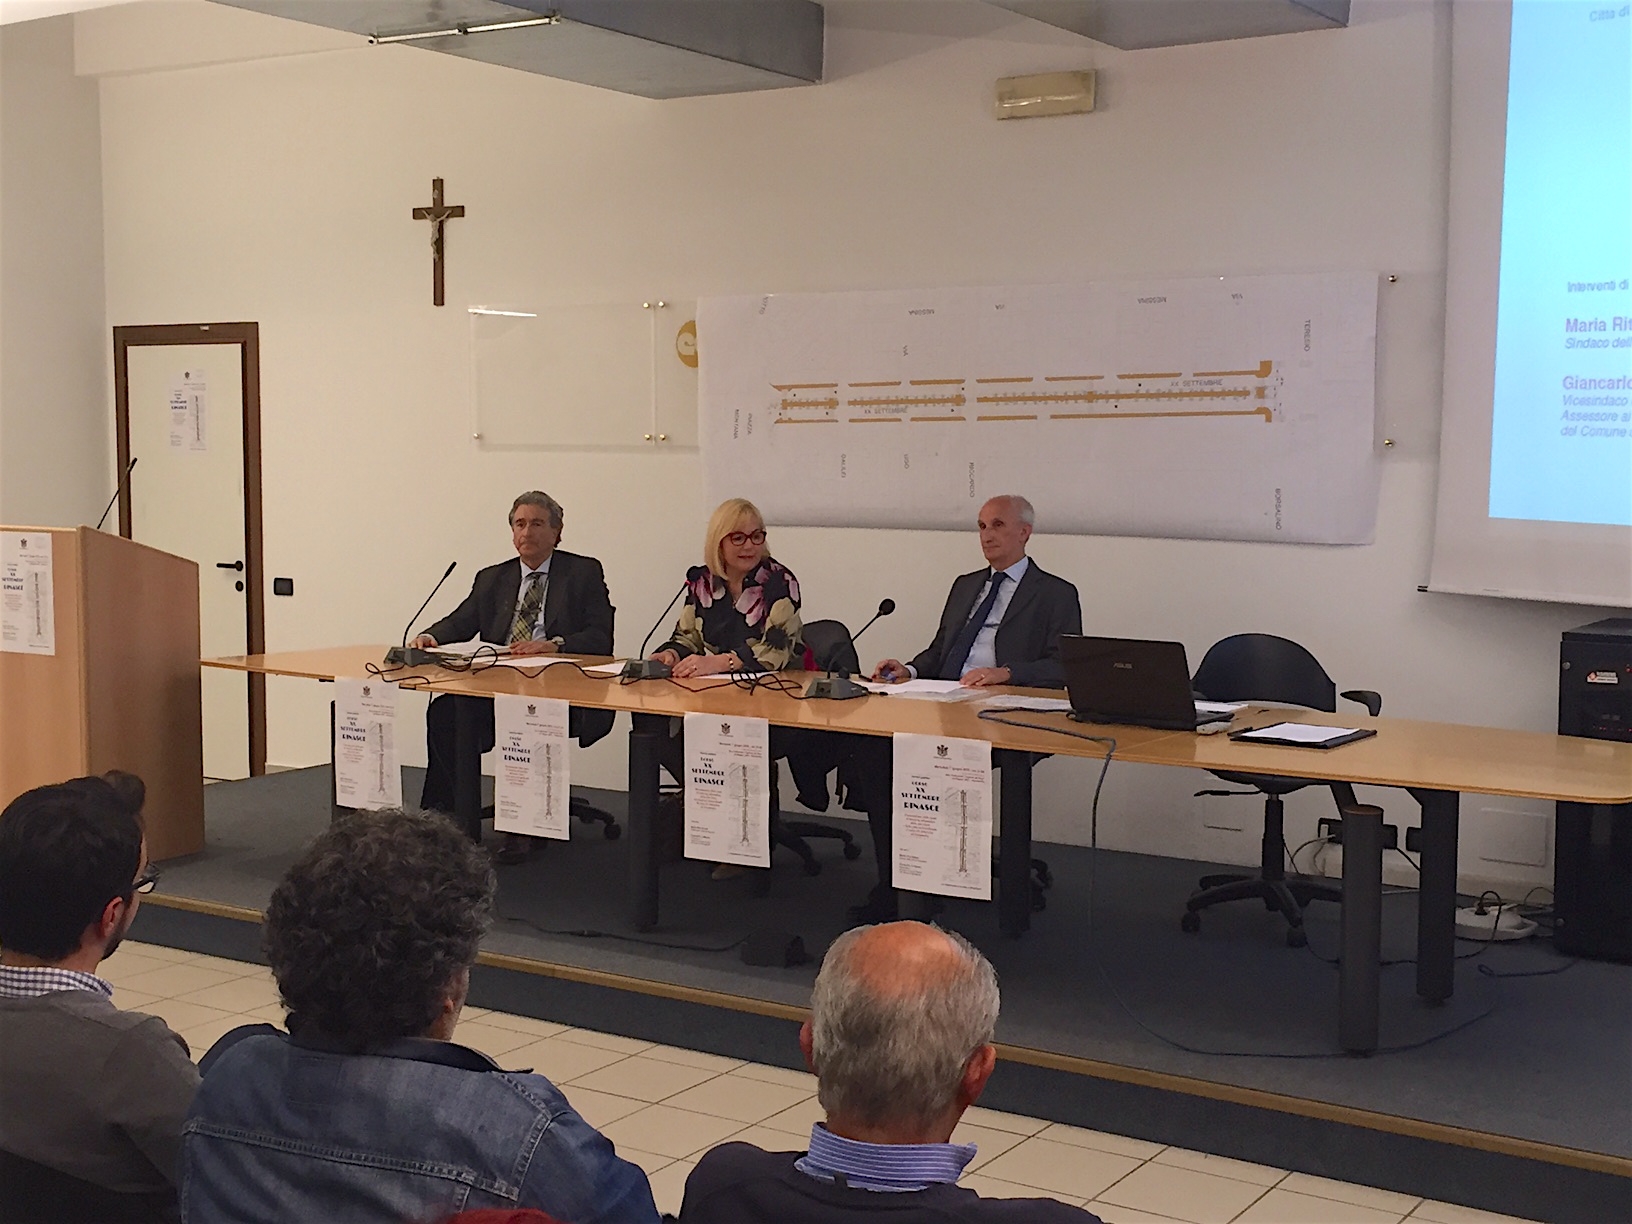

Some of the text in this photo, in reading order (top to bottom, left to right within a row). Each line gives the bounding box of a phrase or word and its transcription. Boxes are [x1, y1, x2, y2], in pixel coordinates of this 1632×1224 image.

[1567, 279, 1629, 292] Interventi di
[1566, 318, 1606, 332] Maria
[1565, 337, 1610, 349] Sindaco
[1182, 378, 1223, 387] SETTEMBRE
[1563, 394, 1628, 406] Vicesindaco
[1561, 410, 1618, 422] Assessore
[1561, 425, 1577, 437] del
[1580, 425, 1627, 437] Comune
[694, 777, 725, 785] RINASCE
[901, 792, 940, 801] SETTEMBRE
[904, 801, 940, 812] RINASCE
